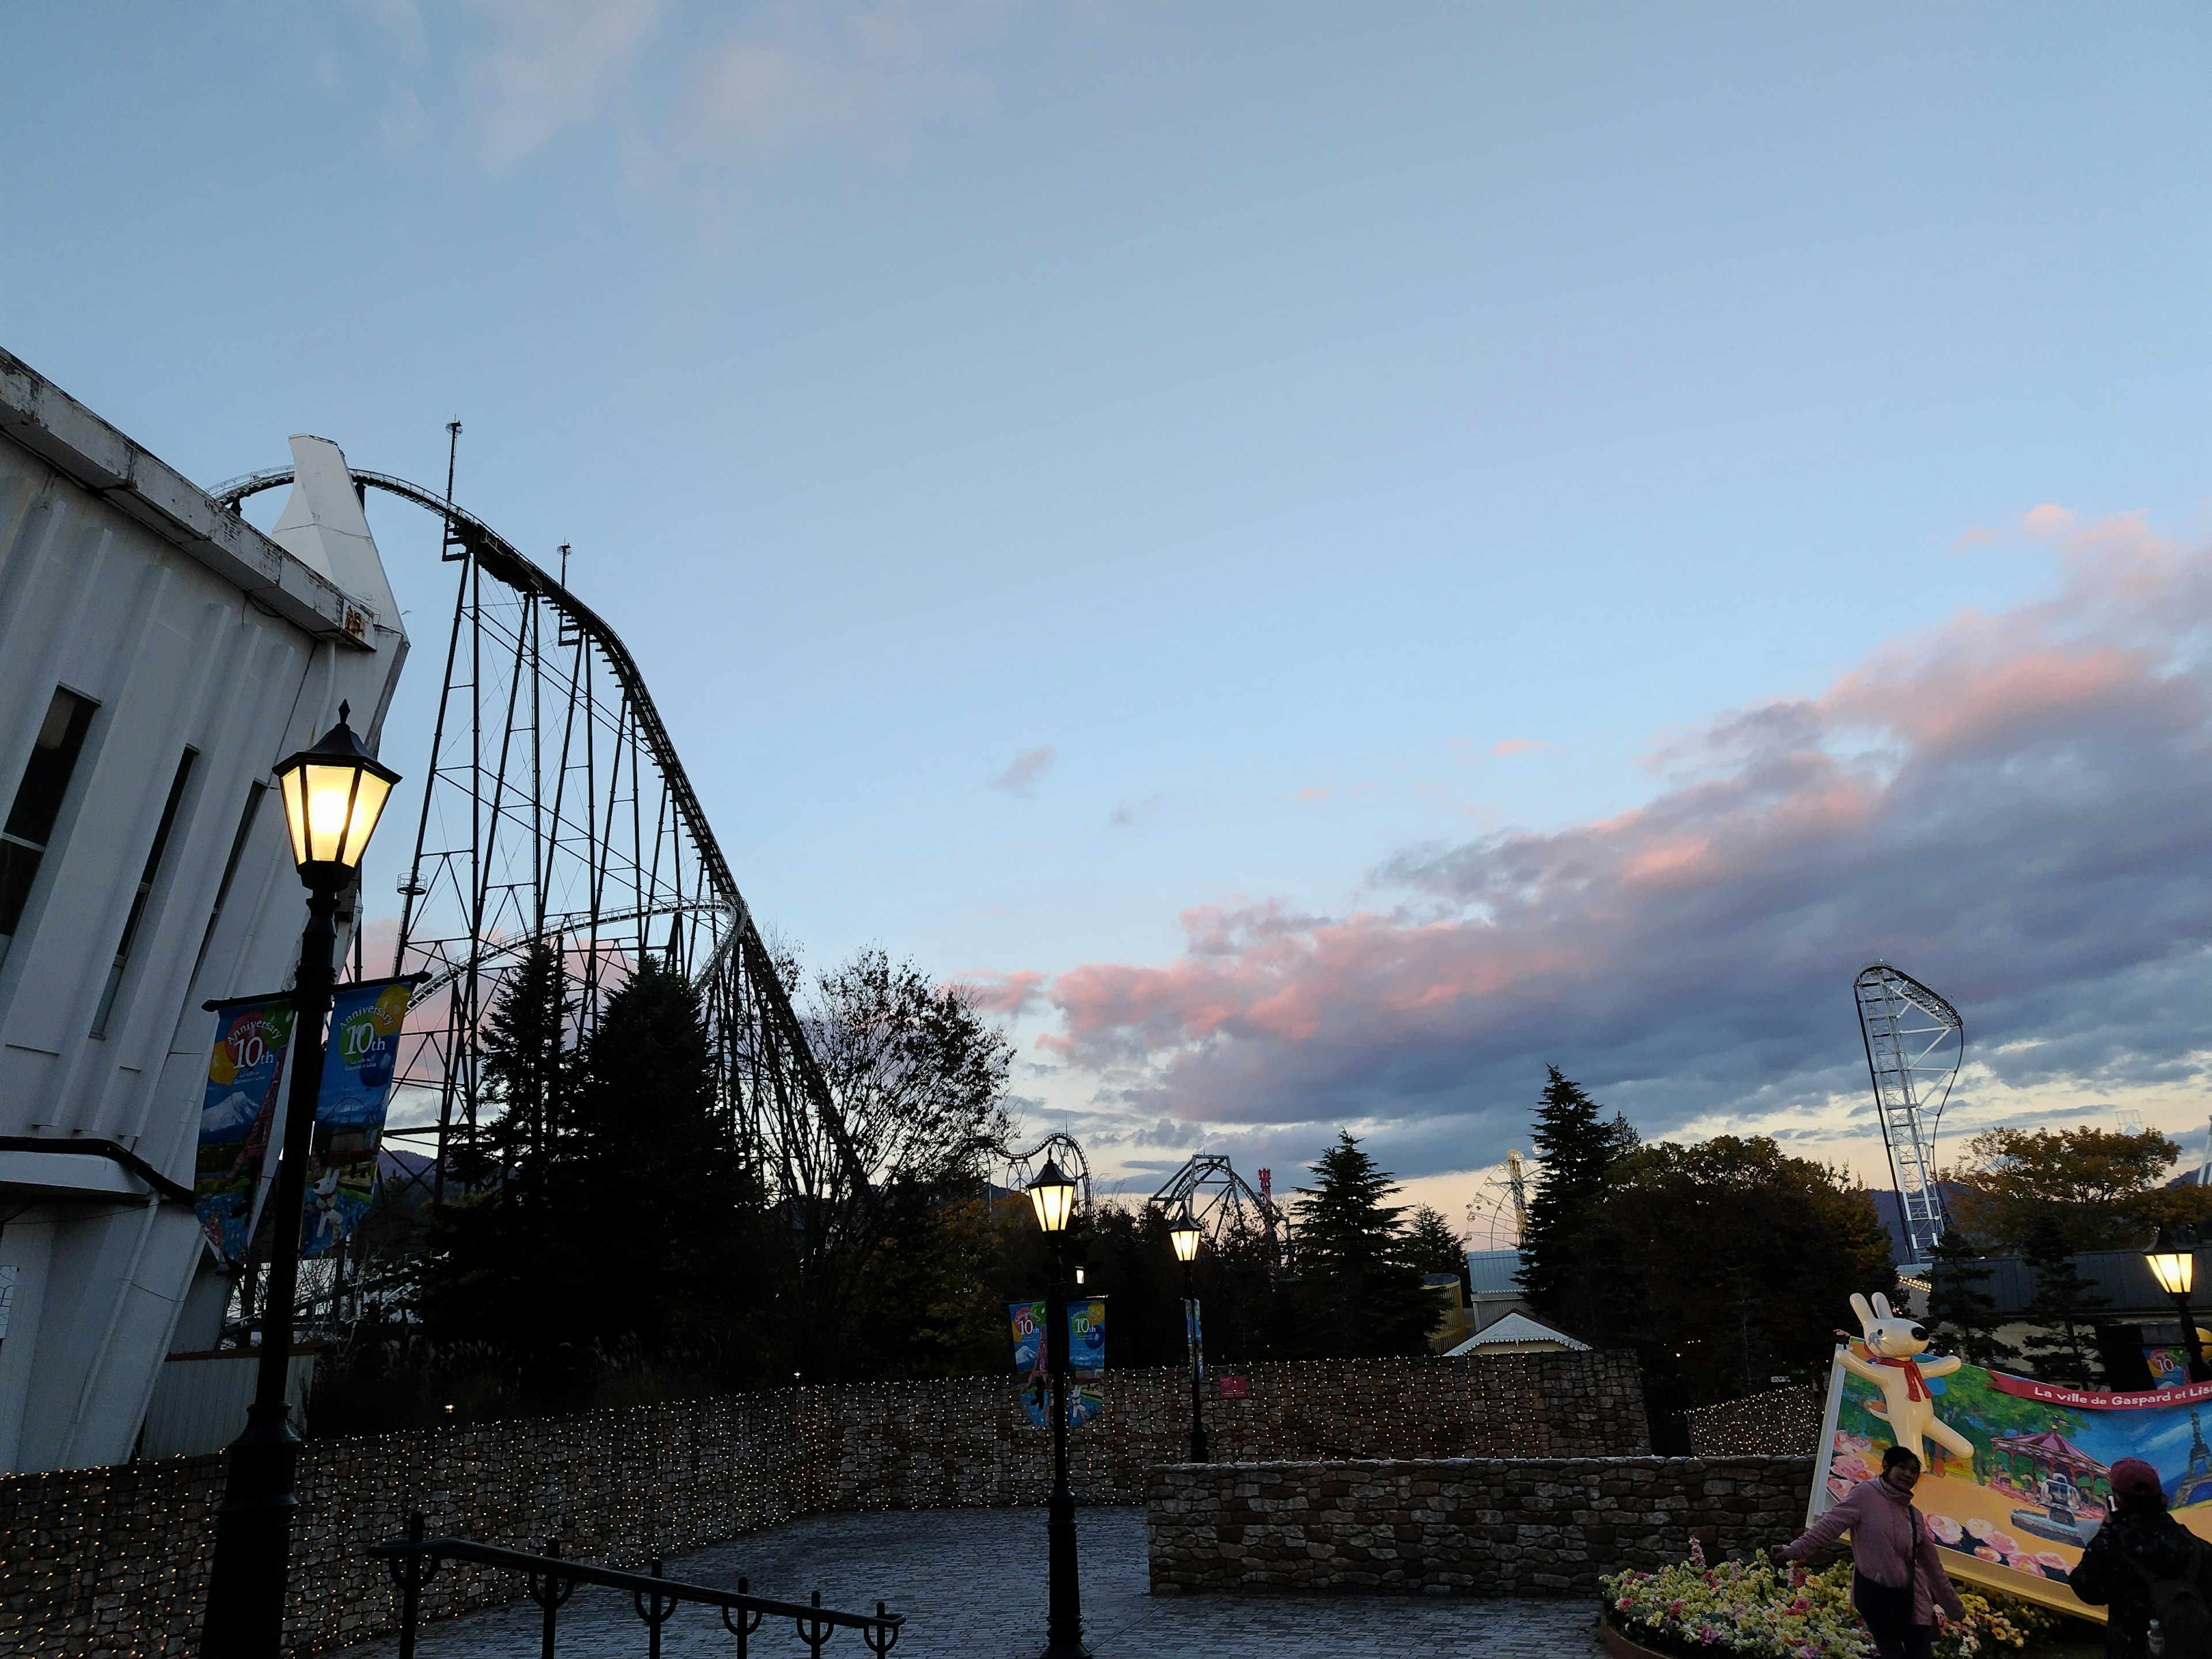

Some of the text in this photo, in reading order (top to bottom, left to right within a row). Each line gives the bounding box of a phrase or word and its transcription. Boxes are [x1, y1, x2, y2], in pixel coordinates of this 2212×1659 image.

[340, 1005, 393, 1031] Anniversary
[227, 1020, 282, 1044] Anniversary
[344, 1022, 385, 1055] 10th
[233, 1036, 274, 1069] 10th
[1018, 1319, 1040, 1335] 10th
[1074, 1318, 1096, 1333] 10th
[2034, 1387, 2052, 1398] La
[2056, 1393, 2088, 1404] ville
[2090, 1396, 2107, 1406] de
[2111, 1391, 2171, 1407] Gaspard
